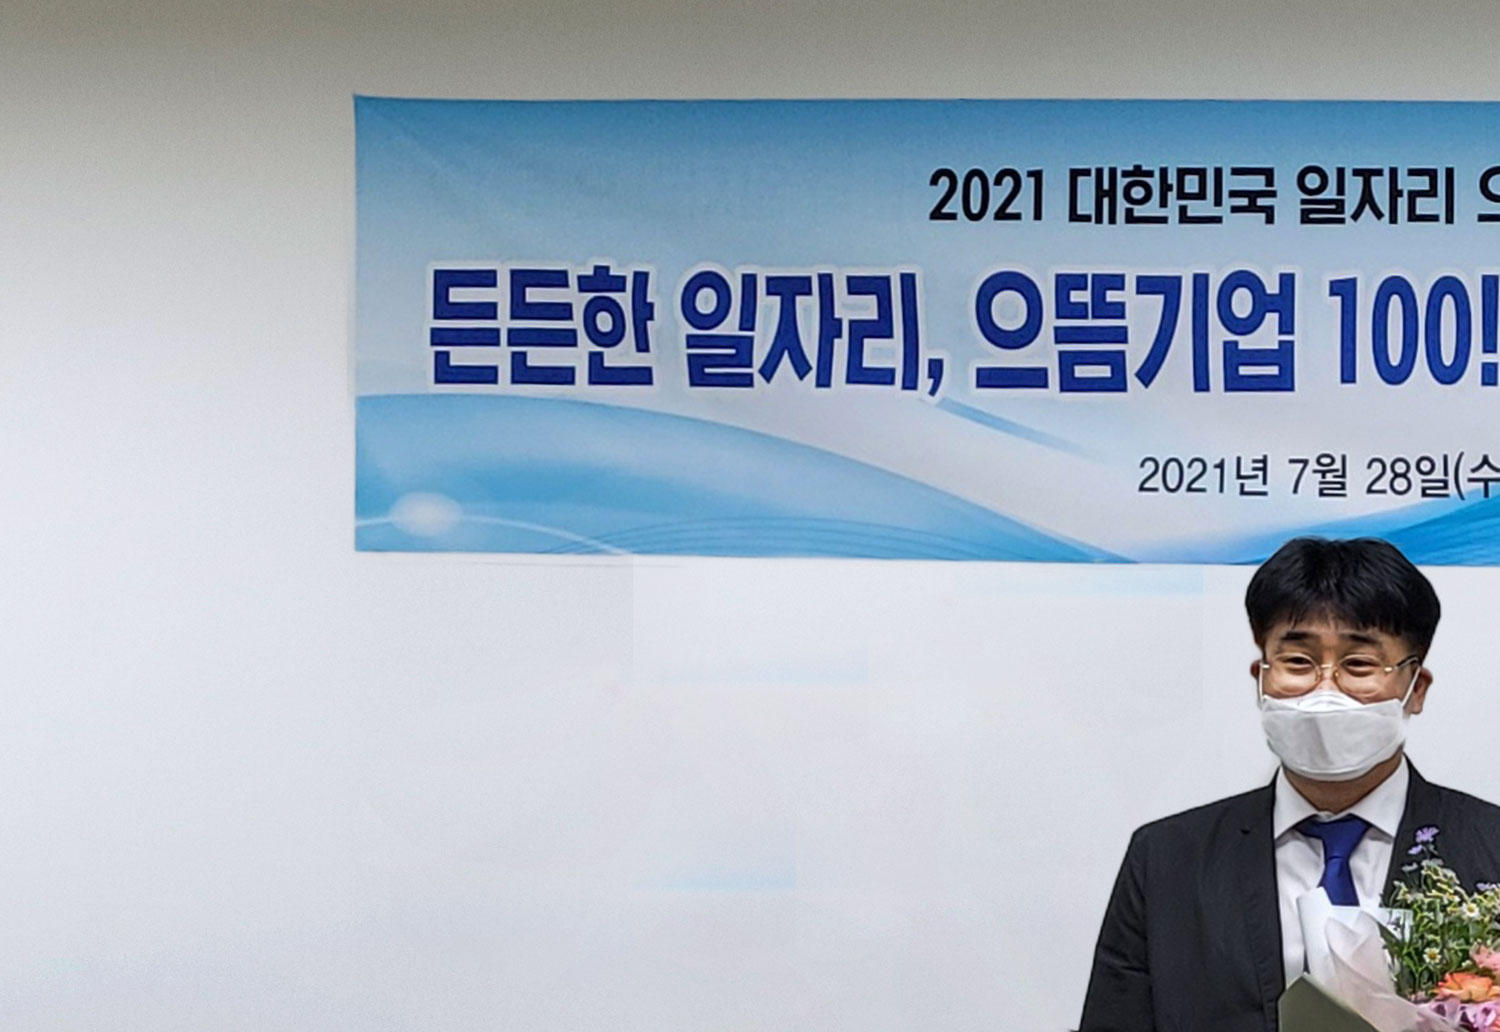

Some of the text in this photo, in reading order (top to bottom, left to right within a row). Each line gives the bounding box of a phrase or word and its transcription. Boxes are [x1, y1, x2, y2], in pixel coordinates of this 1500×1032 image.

[929, 167, 1045, 222] 2021
[1067, 164, 1279, 225] 대한민국
[1296, 164, 1456, 225] 일자리
[429, 264, 655, 386] 든든한
[680, 269, 945, 397] 일자리,
[973, 268, 1297, 394] 으뜸기업
[1328, 273, 1500, 388] 100!
[1137, 453, 1270, 497] 2021년
[1287, 453, 1349, 497] 7월
